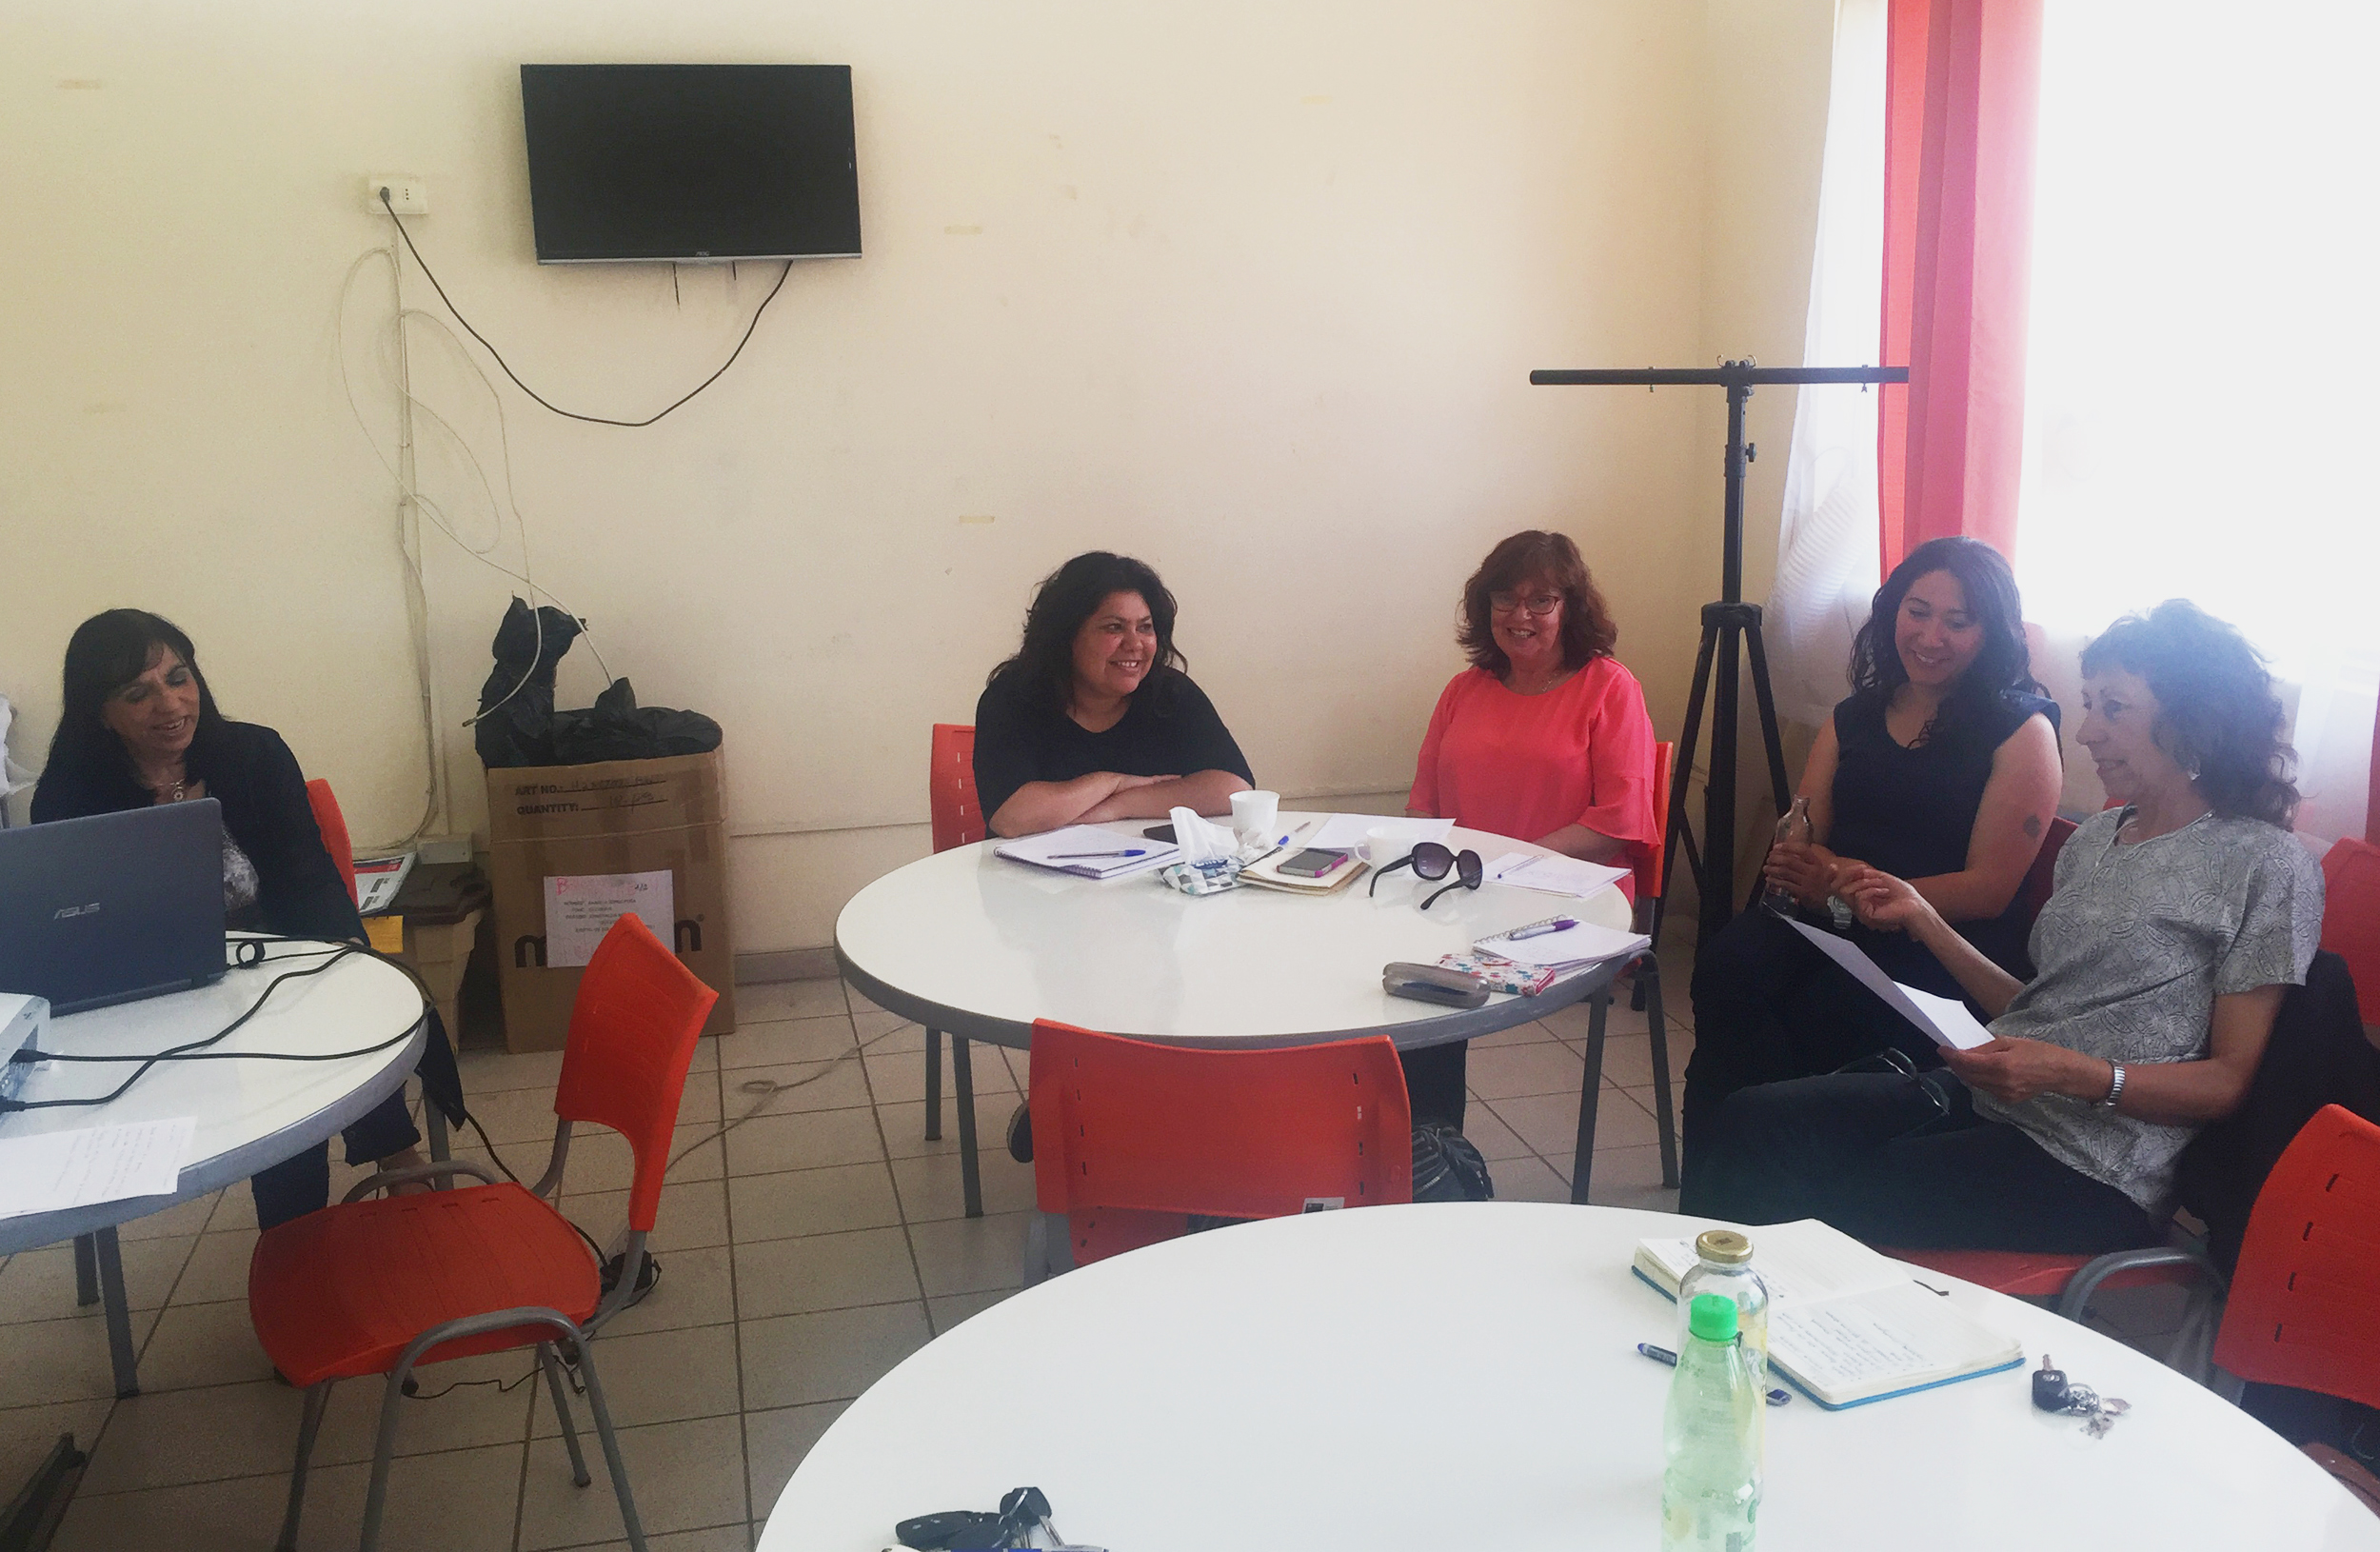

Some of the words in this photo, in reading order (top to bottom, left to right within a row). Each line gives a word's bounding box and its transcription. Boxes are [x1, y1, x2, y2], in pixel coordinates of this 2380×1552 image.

[515, 786, 538, 796] ART
[516, 803, 579, 815] QUANTITY:
[53, 902, 100, 921] ASUS
